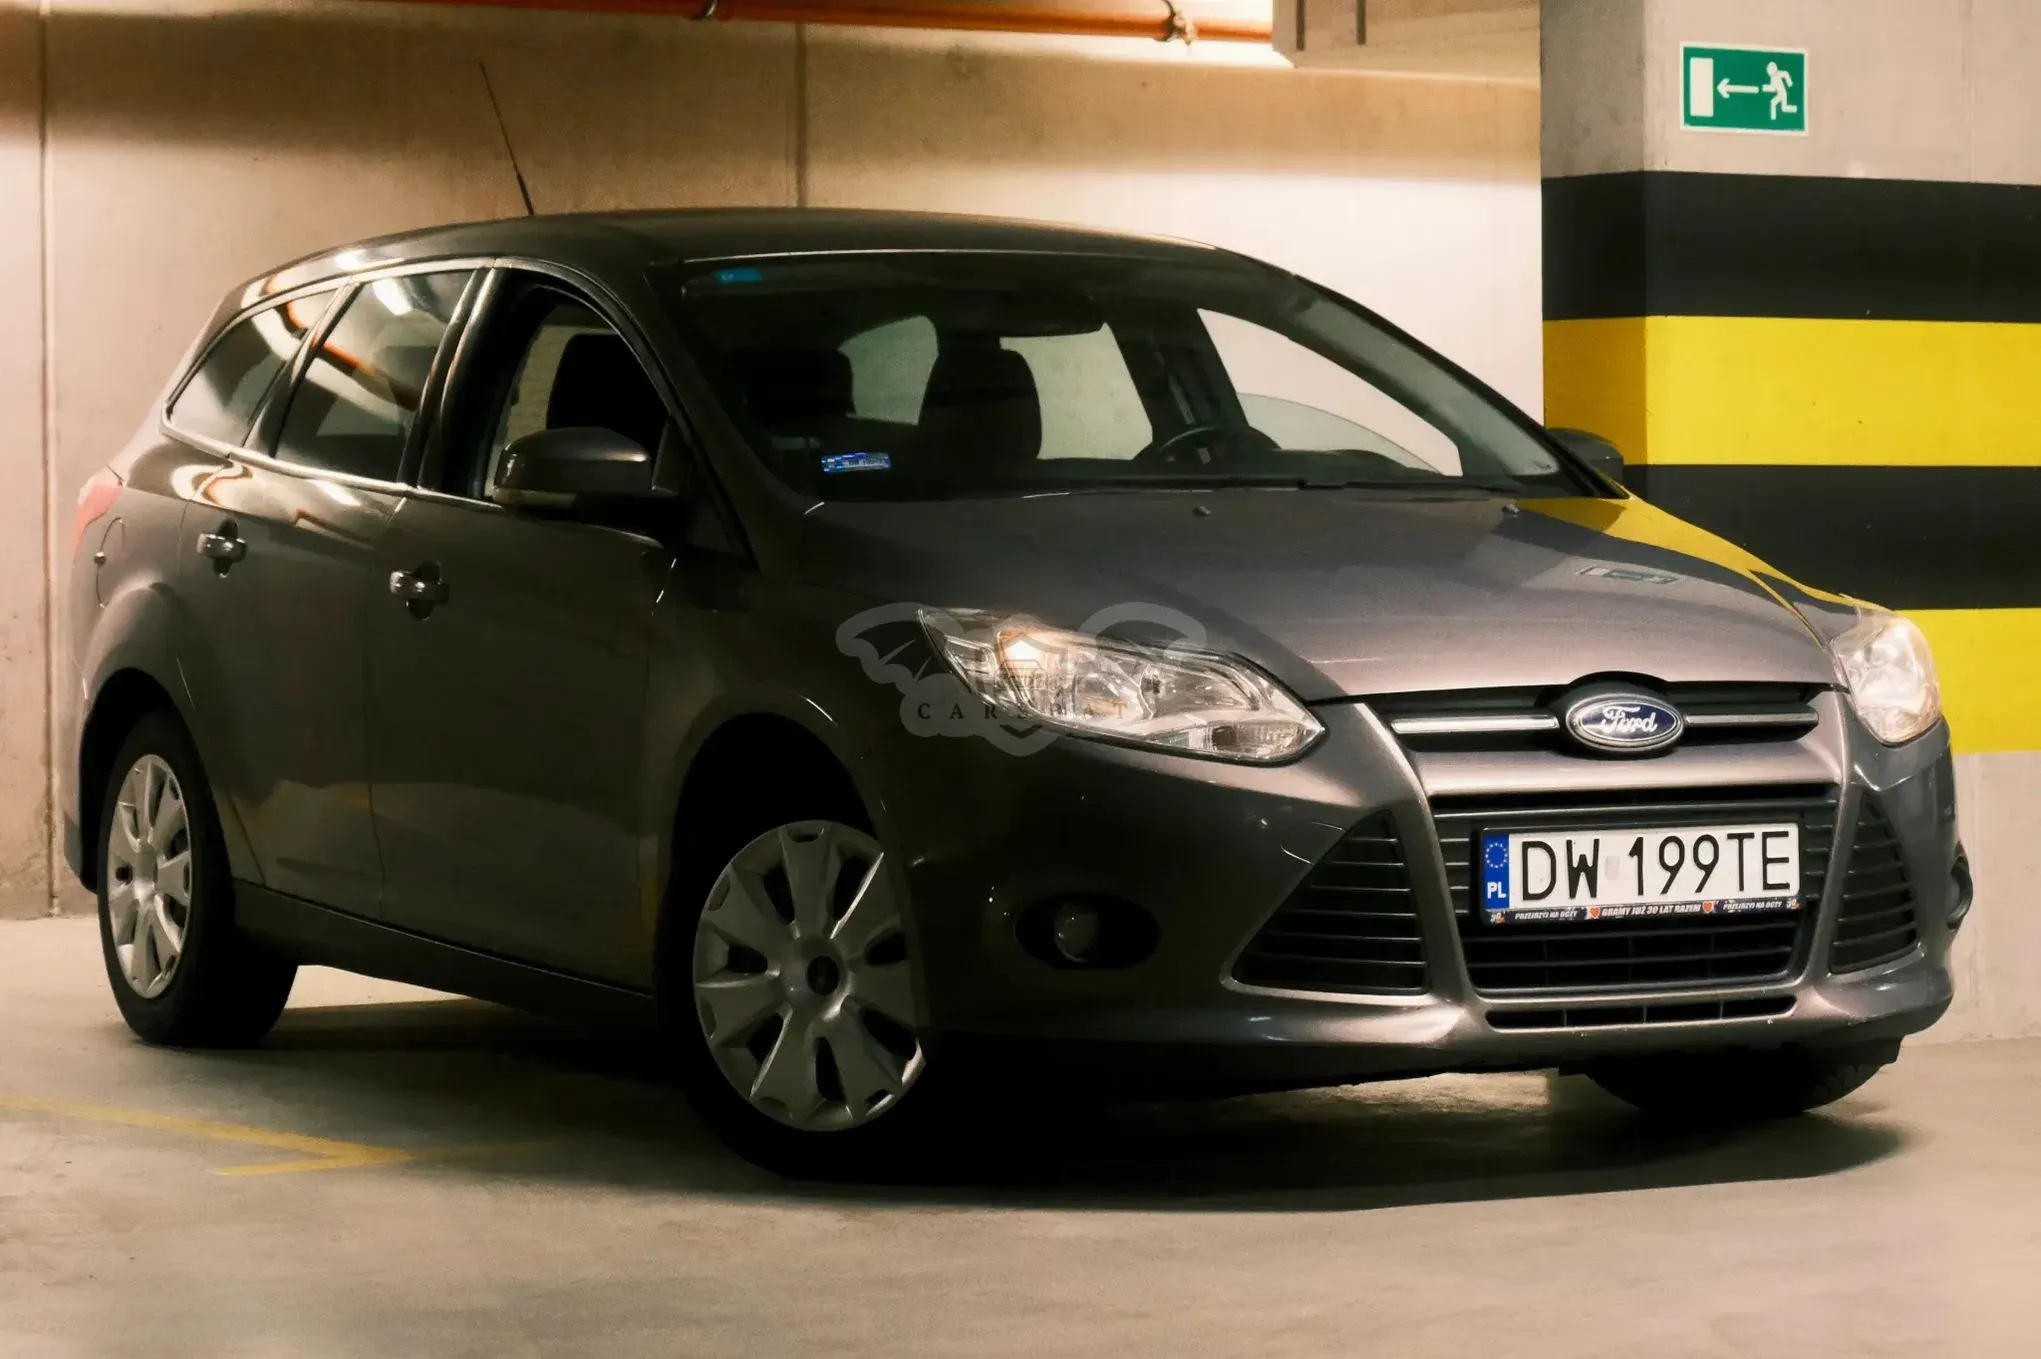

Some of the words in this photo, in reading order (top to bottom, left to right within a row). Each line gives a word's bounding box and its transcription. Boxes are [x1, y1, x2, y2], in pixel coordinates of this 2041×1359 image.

[1600, 706, 1658, 733] Ford
[1521, 838, 1600, 901] DW
[1628, 830, 1790, 896] 199TE
[1486, 881, 1507, 899] PL
[1646, 905, 1659, 915] 30
[1659, 905, 1674, 914] LAT
